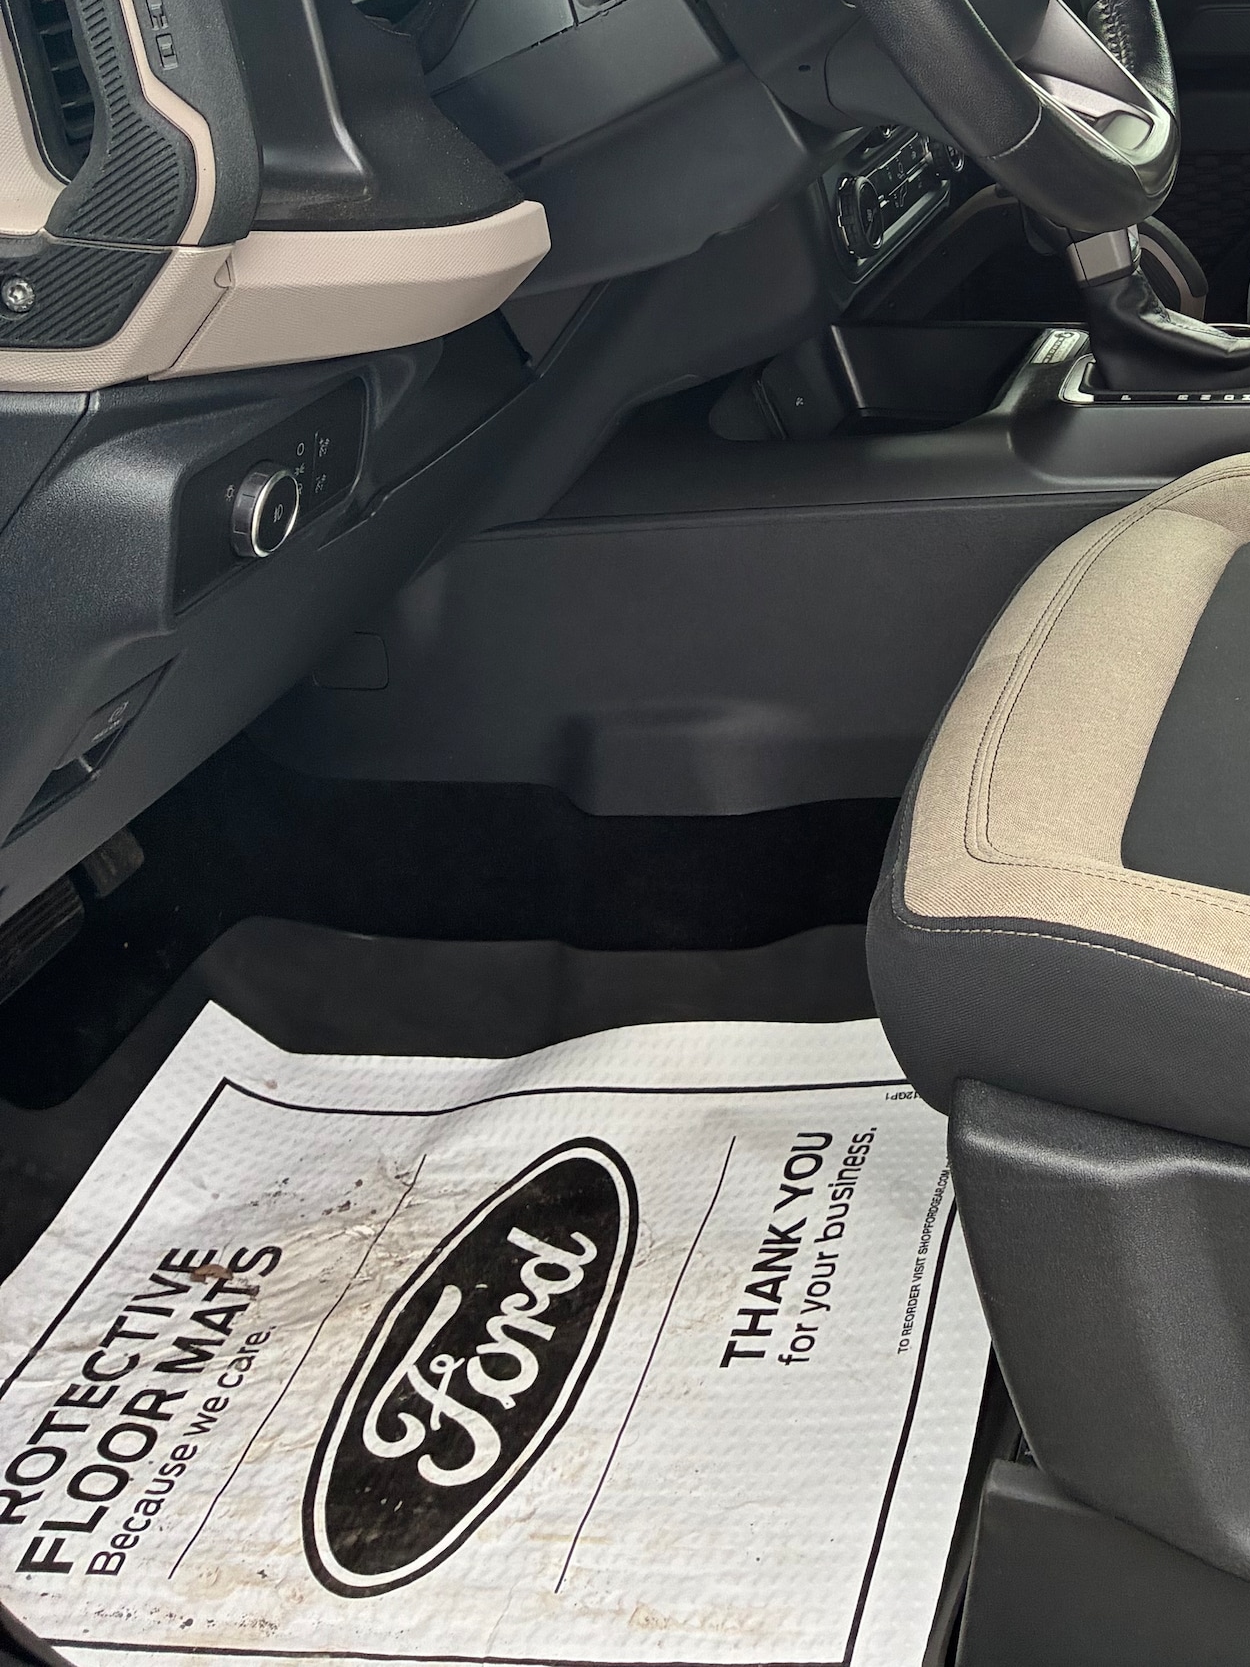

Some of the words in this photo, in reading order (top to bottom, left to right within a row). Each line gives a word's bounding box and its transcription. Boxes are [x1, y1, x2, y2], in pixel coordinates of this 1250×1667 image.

[814, 1127, 877, 1244] business.
[719, 1216, 807, 1368] THANK
[773, 1131, 833, 1213] YOU
[800, 1251, 839, 1315] your
[912, 1257, 926, 1283] VISIT
[362, 1226, 598, 1486] Ford
[777, 1323, 819, 1366] for
[897, 1337, 911, 1354] TO
[901, 1283, 921, 1337] REORDER
[0, 1248, 218, 1525] ROTECTIVE
[15, 1389, 189, 1574] FLOOR
[153, 1245, 283, 1373] MATS
[85, 1443, 198, 1576] Because
[183, 1394, 230, 1437] we
[217, 1325, 277, 1389] care.
